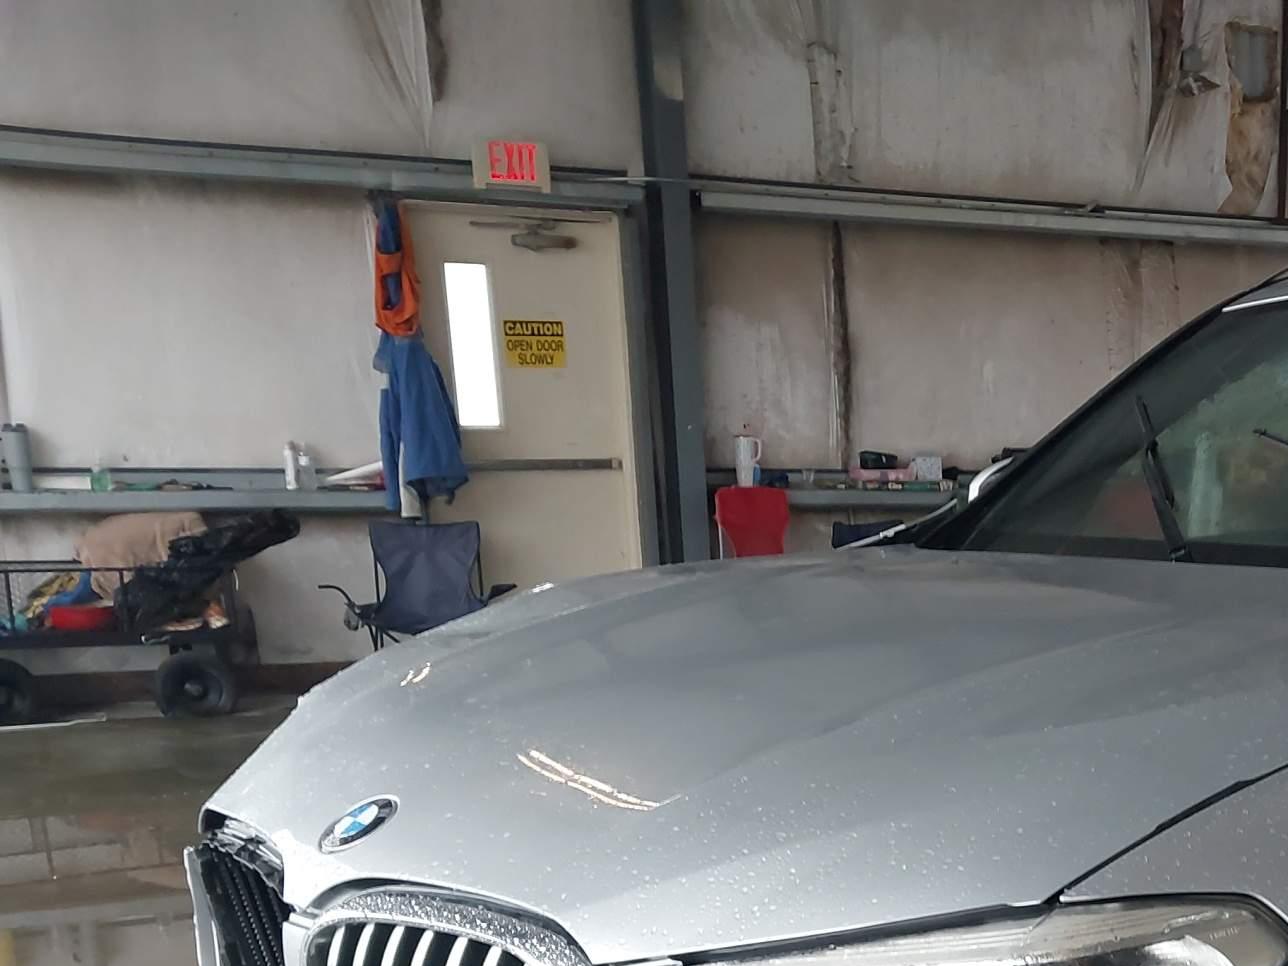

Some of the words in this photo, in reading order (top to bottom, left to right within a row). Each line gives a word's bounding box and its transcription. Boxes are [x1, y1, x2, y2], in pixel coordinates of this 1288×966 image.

[488, 142, 537, 182] EXIT
[504, 322, 563, 336] CAUTION
[506, 339, 533, 352] OPEN
[536, 339, 565, 352] DOOR
[518, 352, 555, 365] SLOWLY
